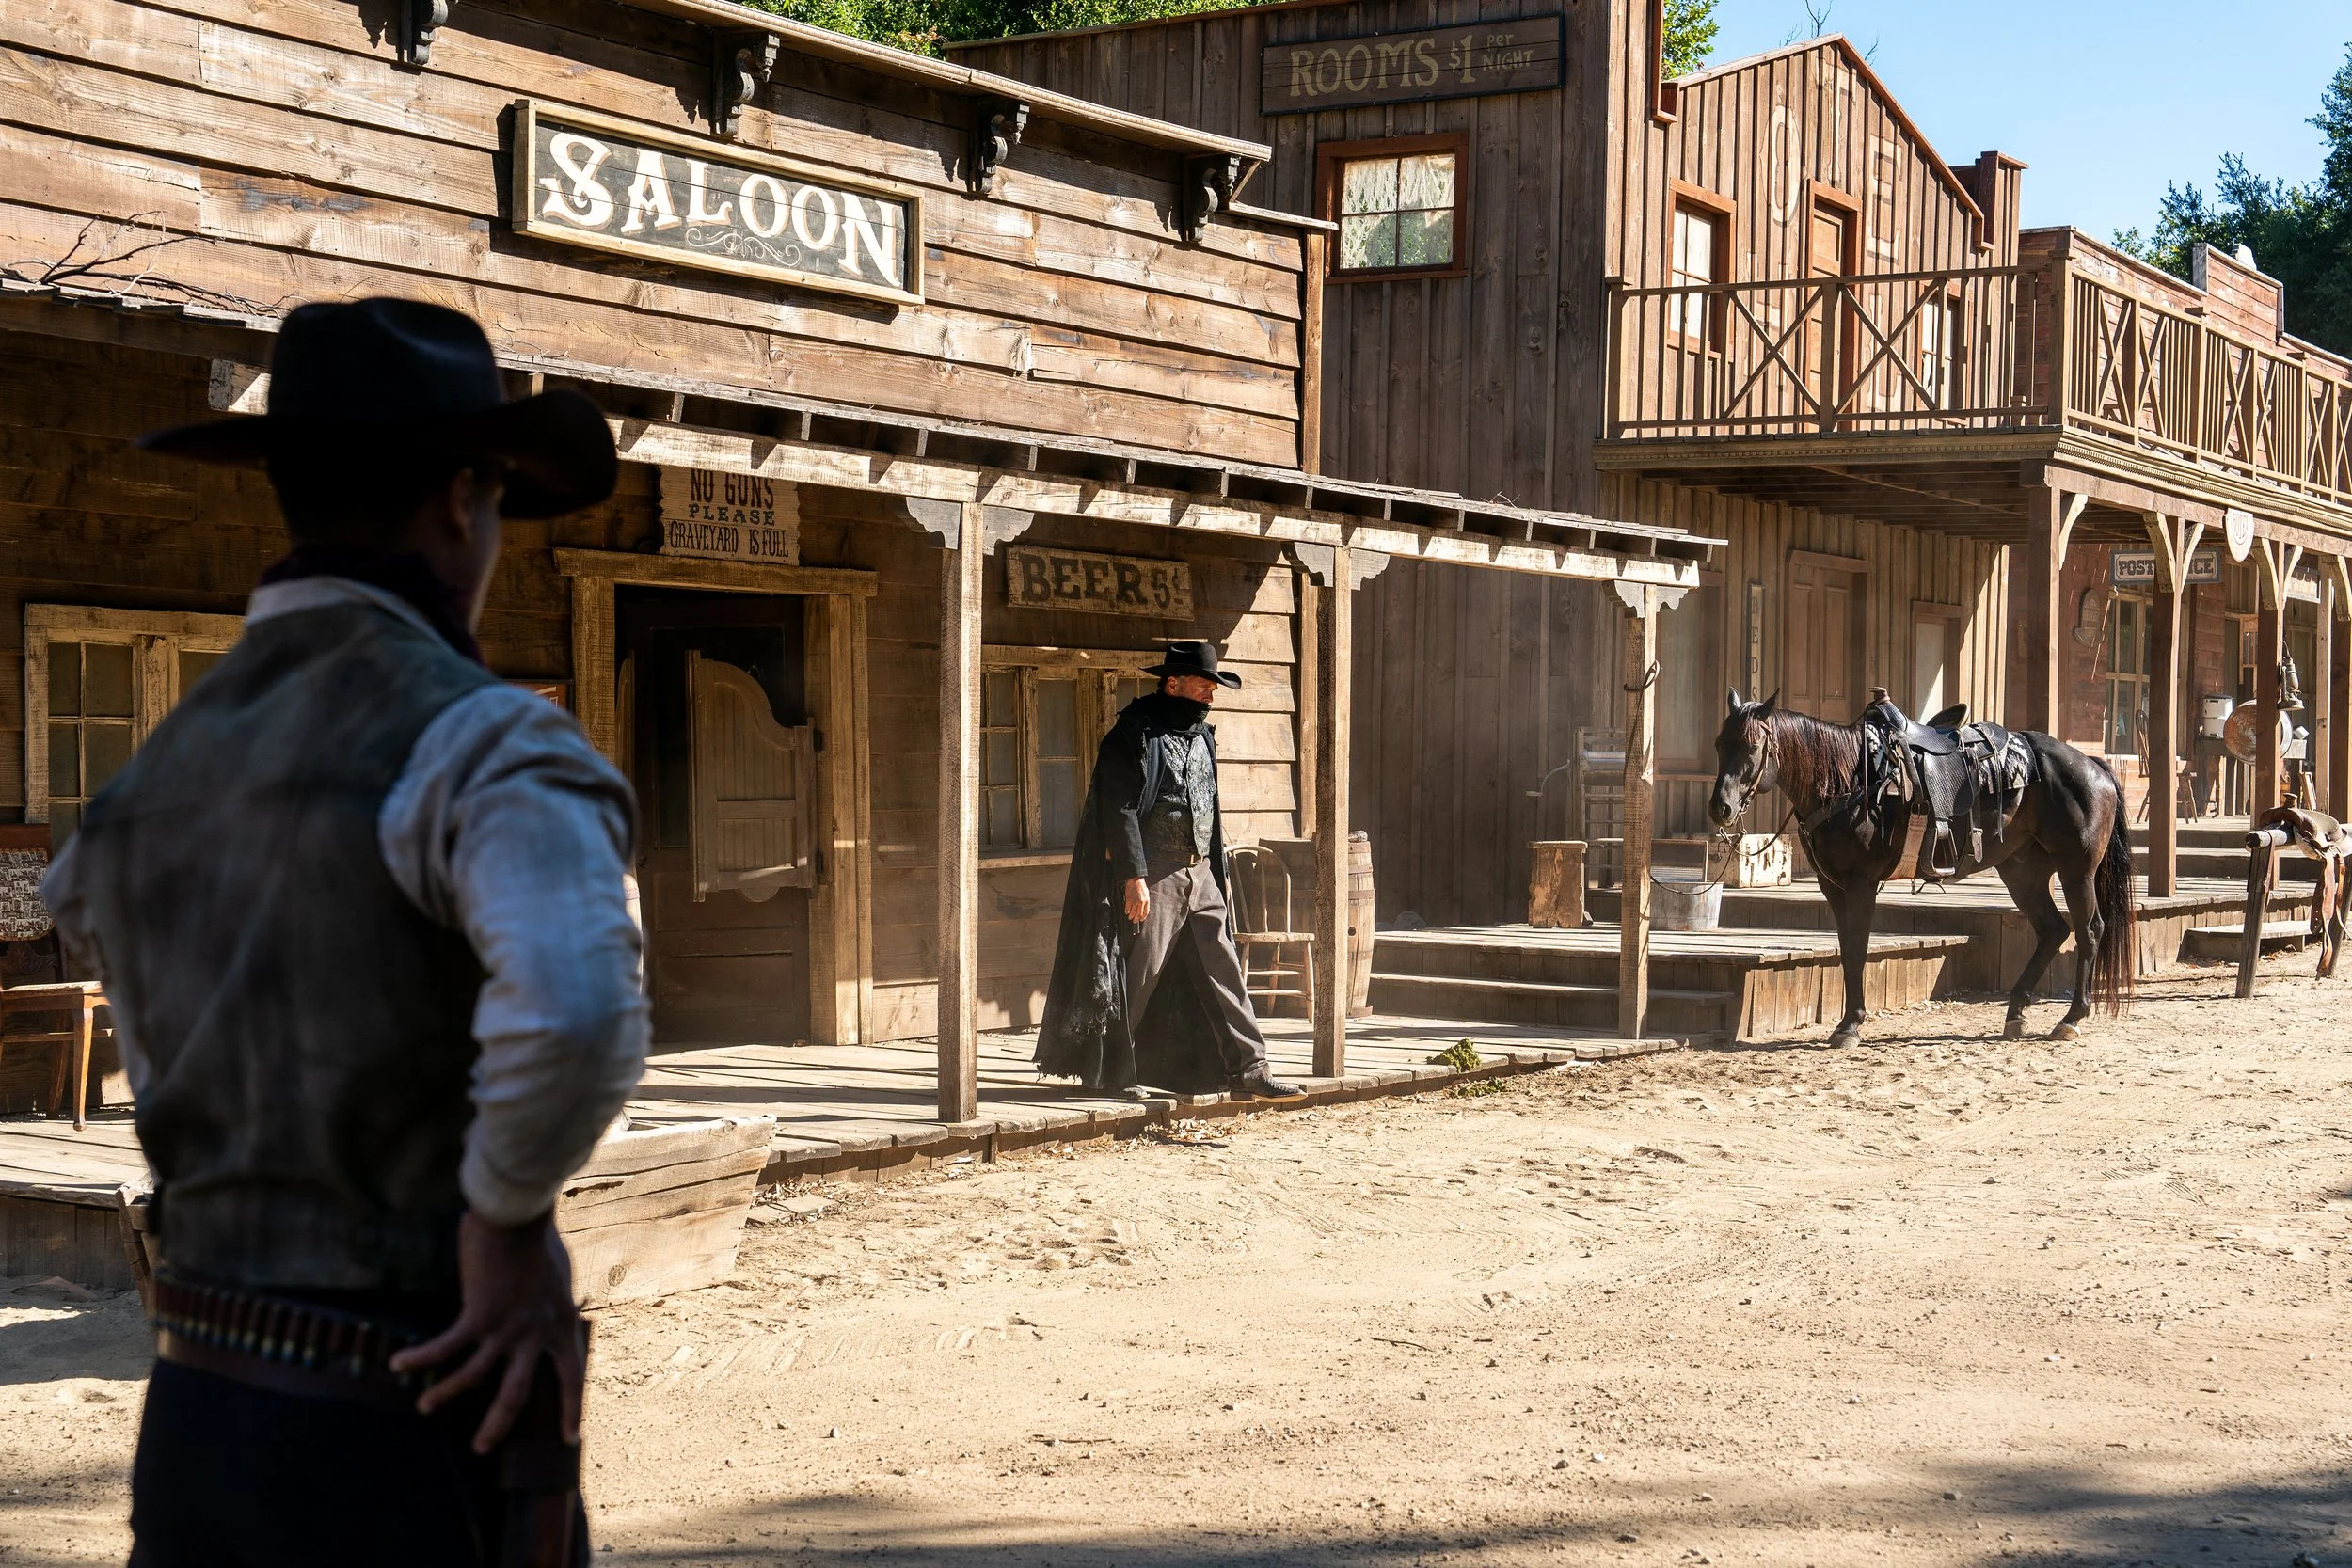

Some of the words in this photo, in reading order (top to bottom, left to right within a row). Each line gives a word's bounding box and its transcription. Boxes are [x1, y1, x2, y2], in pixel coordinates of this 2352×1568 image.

[1483, 49, 1534, 71] NIGHT
[1486, 34, 1514, 52] per
[1290, 38, 1438, 97] ROOMS
[1449, 34, 1476, 84] $1
[539, 132, 902, 288] SALOON
[691, 468, 715, 503] NO
[724, 472, 774, 510] GUNS
[689, 503, 775, 526] PLEASE
[669, 520, 739, 553] GRAVEYARD
[749, 529, 759, 555] IS
[761, 530, 789, 558] FULL
[1018, 553, 1148, 606] BEER
[2119, 560, 2154, 575] POST
